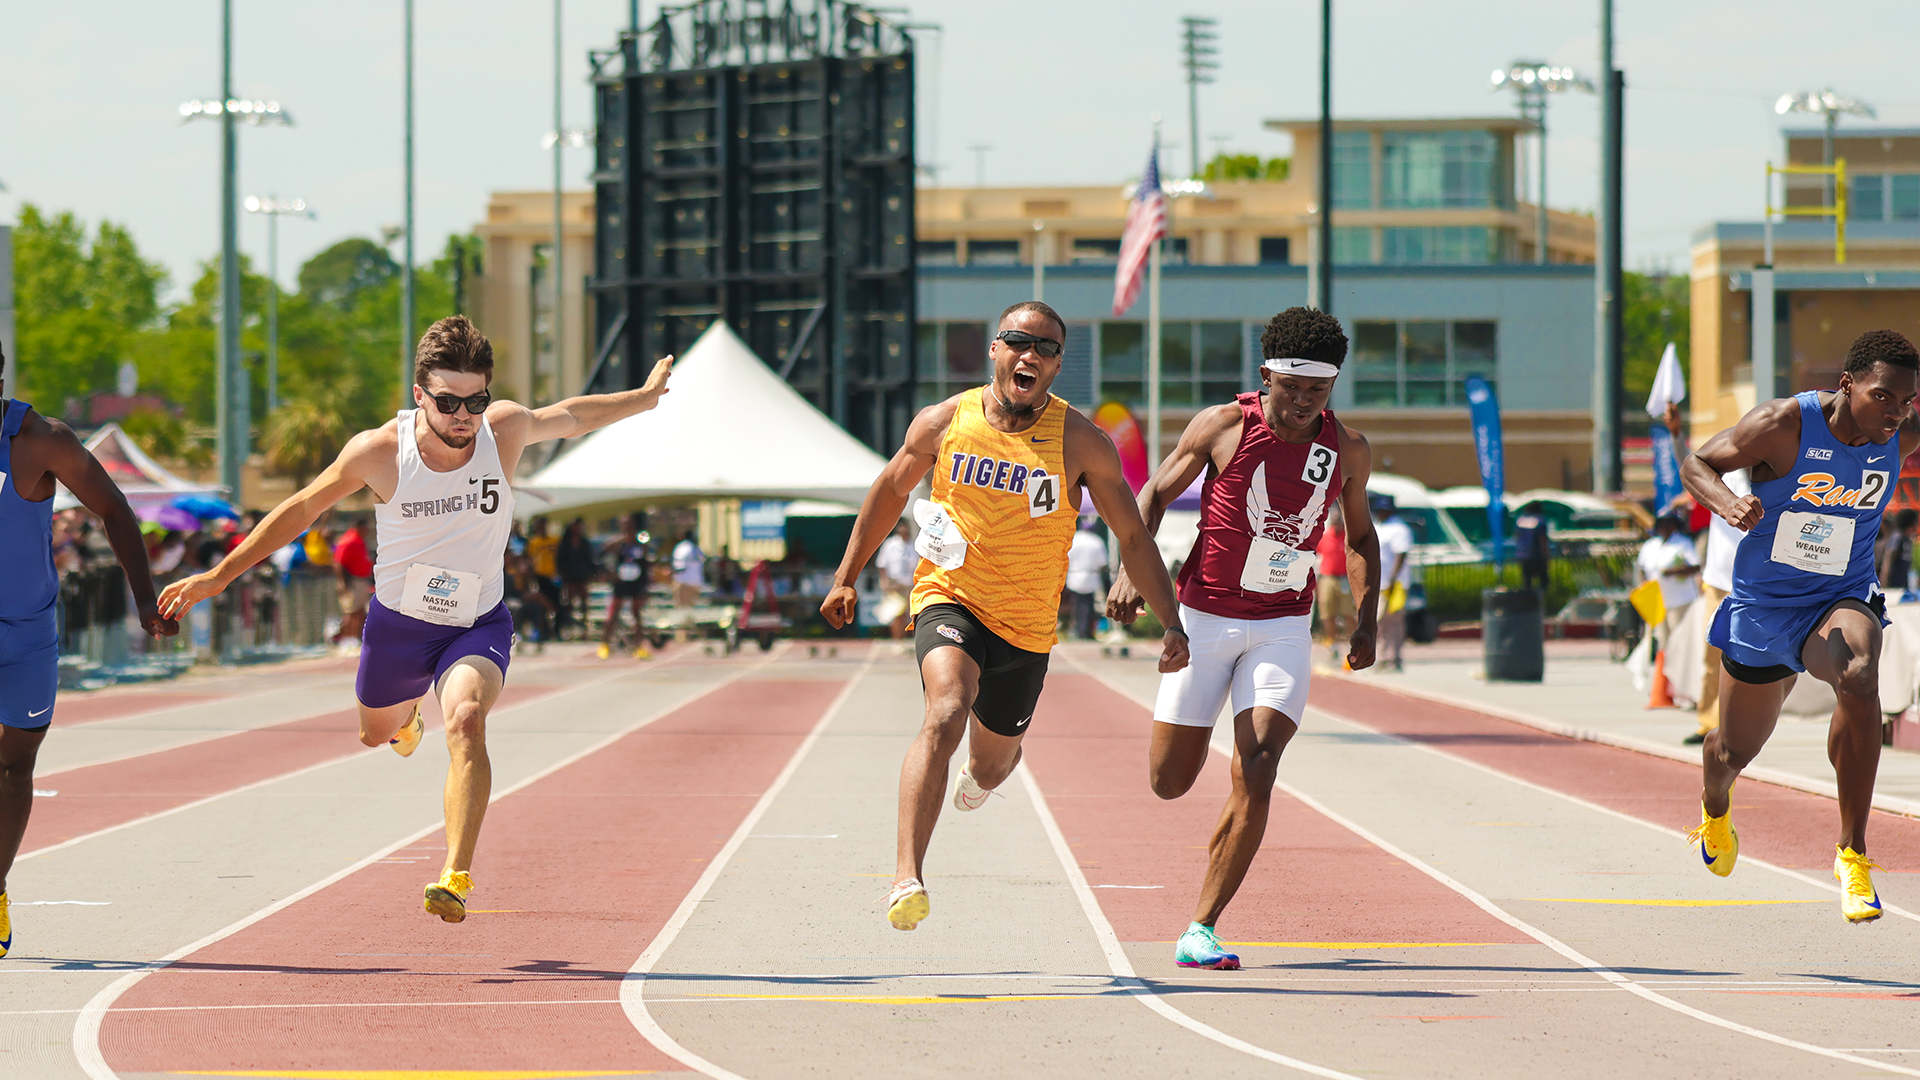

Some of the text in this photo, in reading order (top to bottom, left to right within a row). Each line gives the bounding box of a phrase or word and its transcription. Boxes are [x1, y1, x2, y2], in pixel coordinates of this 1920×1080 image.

[1805, 447, 1832, 460] SIAC
[1307, 448, 1332, 483] 3
[480, 479, 500, 515] 5
[1033, 478, 1056, 512] 4
[1857, 473, 1884, 507] 2
[401, 495, 463, 518] SPRING
[1801, 523, 1833, 538] SIAC
[1795, 540, 1831, 555] WEAVER
[1803, 552, 1819, 561] JACE
[1269, 568, 1290, 578] ROSE
[428, 578, 460, 592] SIAC
[422, 594, 459, 608] NASTASI
[427, 605, 450, 614] GRANT
